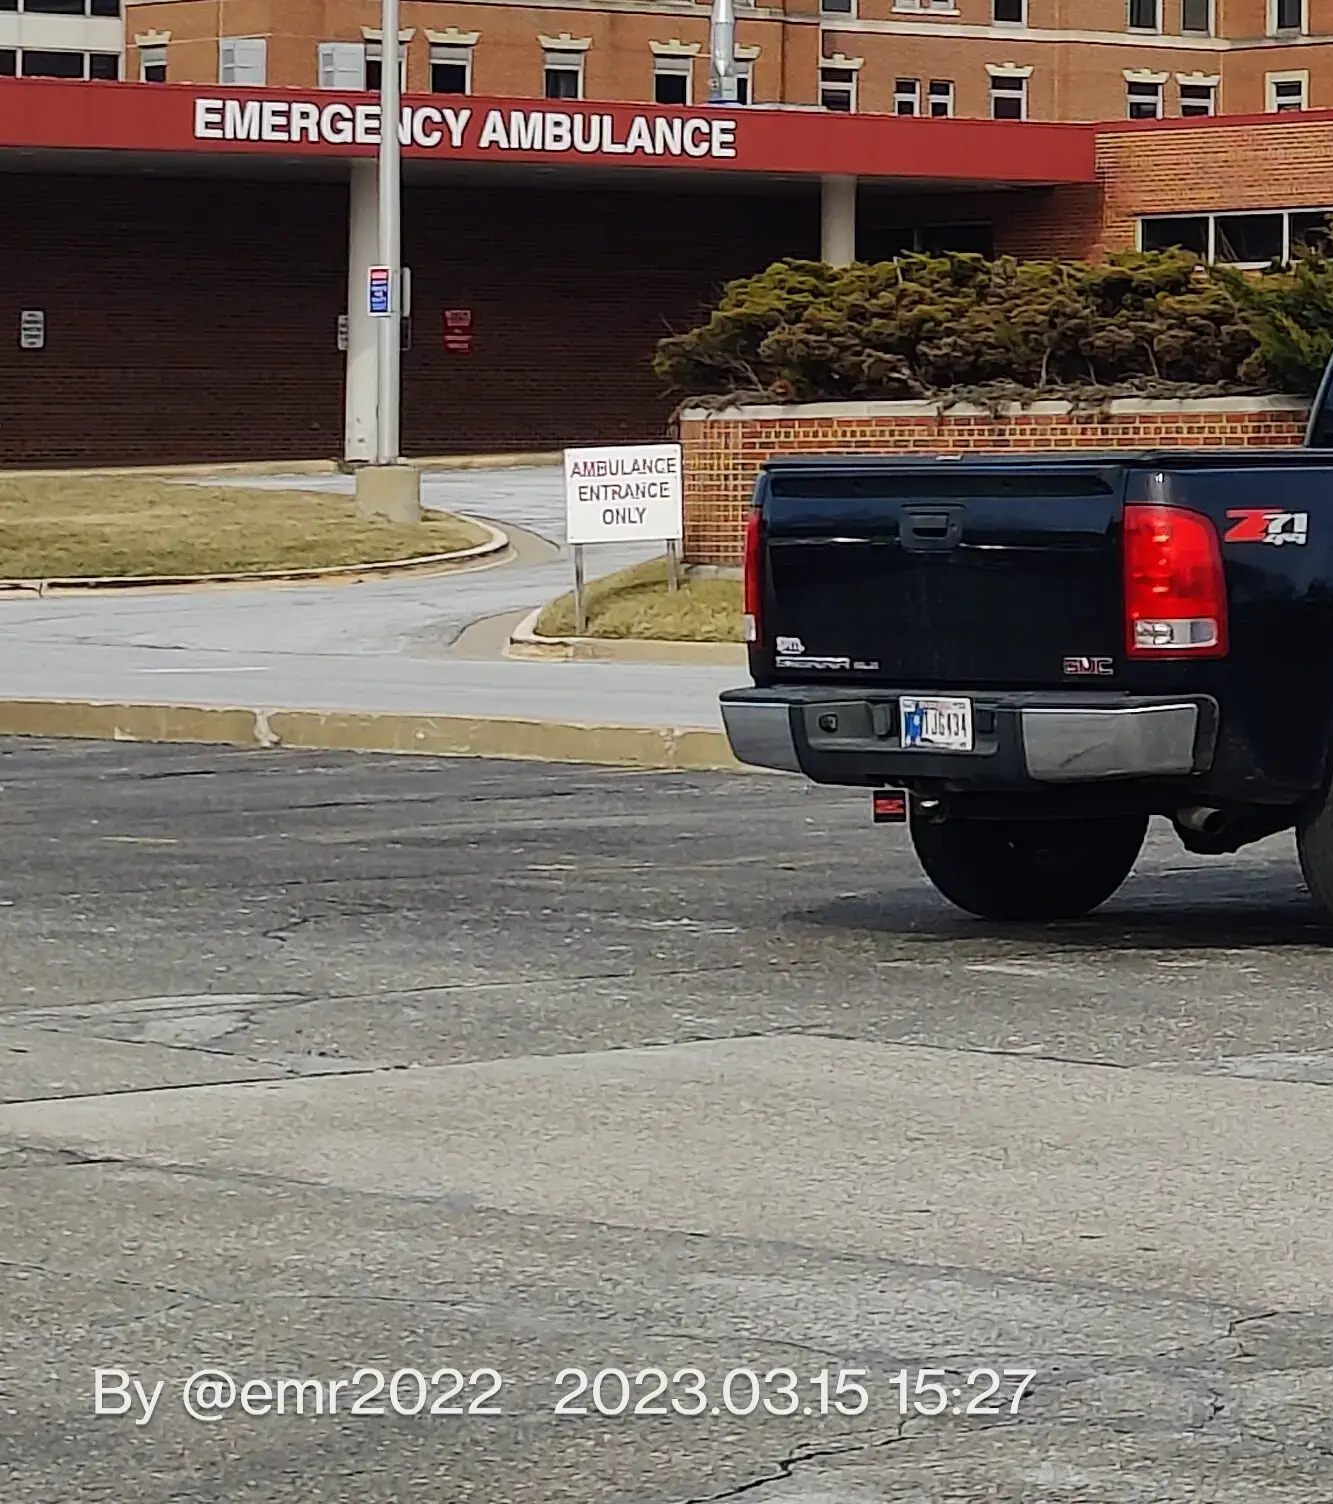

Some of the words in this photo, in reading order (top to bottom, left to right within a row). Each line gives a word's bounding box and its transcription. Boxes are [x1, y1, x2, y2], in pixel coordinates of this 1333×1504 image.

[194, 98, 471, 147] EMERGENCY
[478, 109, 737, 158] AMBULANCE
[570, 457, 677, 478] AMBULANCE
[578, 481, 671, 502] ENTRANCE
[602, 506, 648, 525] ONLY
